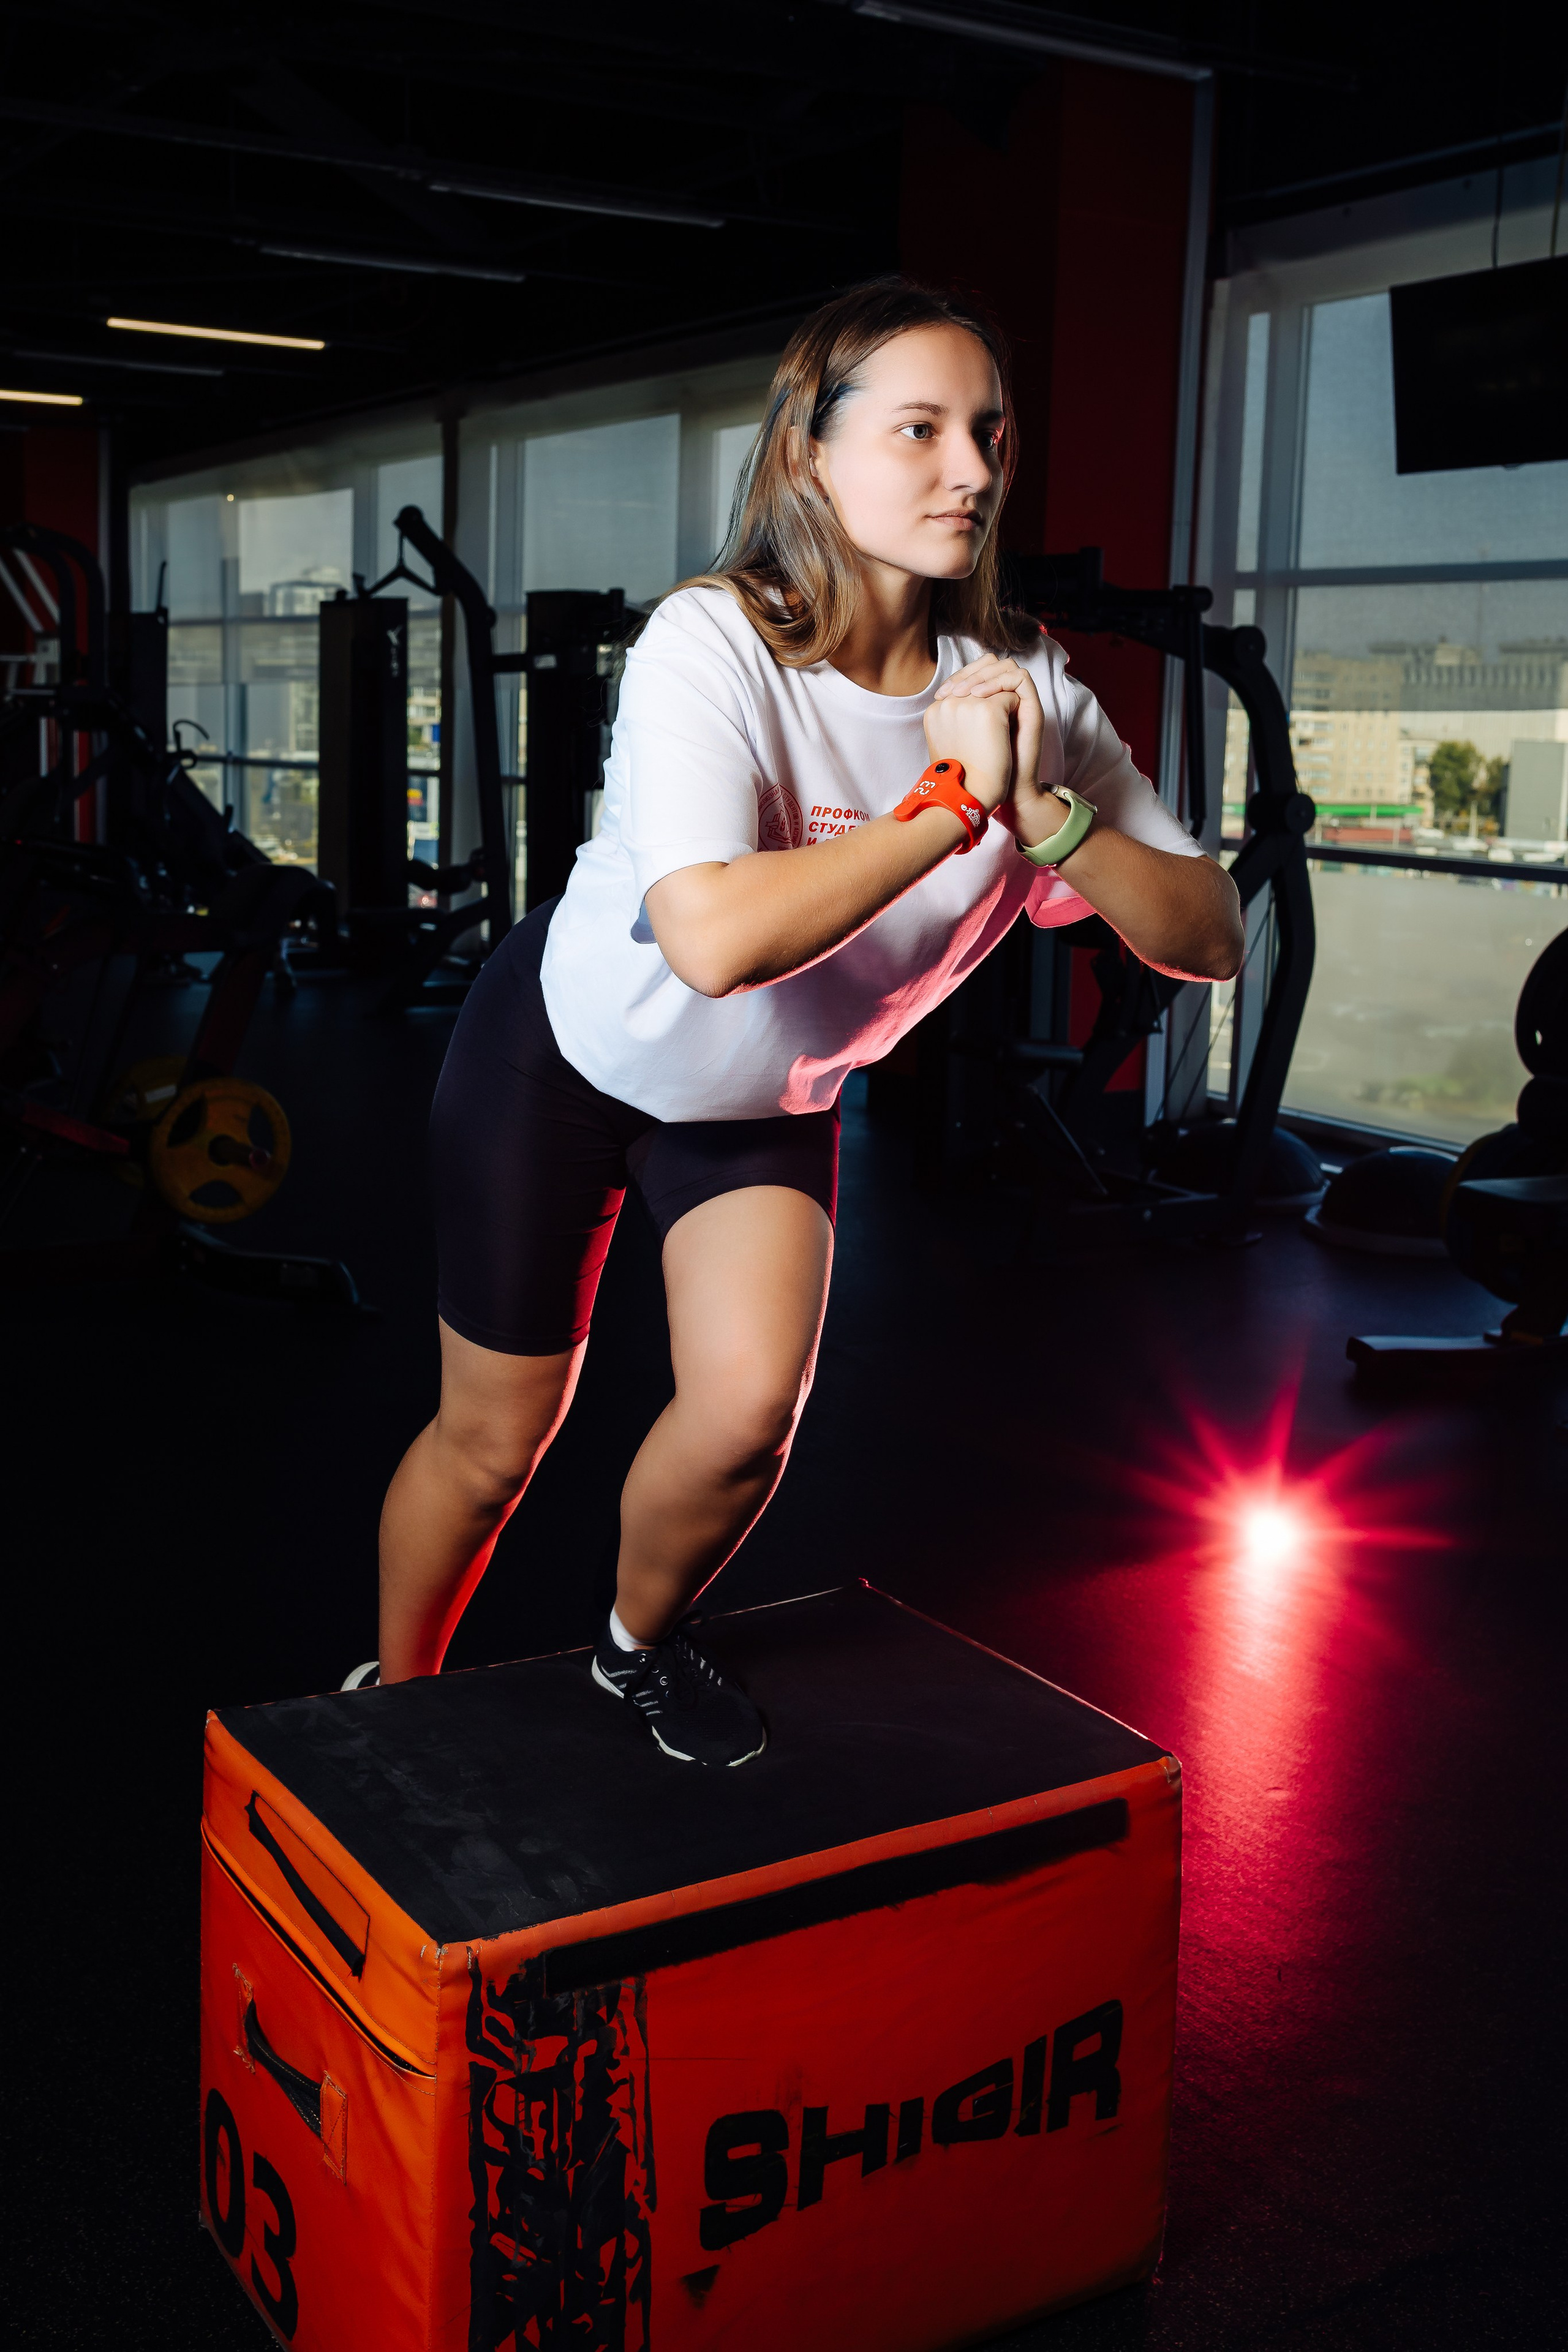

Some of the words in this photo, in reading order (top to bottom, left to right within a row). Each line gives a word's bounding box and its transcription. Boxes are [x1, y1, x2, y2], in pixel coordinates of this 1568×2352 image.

[783, 793, 799, 820] СТУДЕНТОВ
[810, 805, 870, 822] ПРОФКОМ
[699, 1999, 1123, 2251] SHIGIR
[205, 2088, 299, 2342] 03
